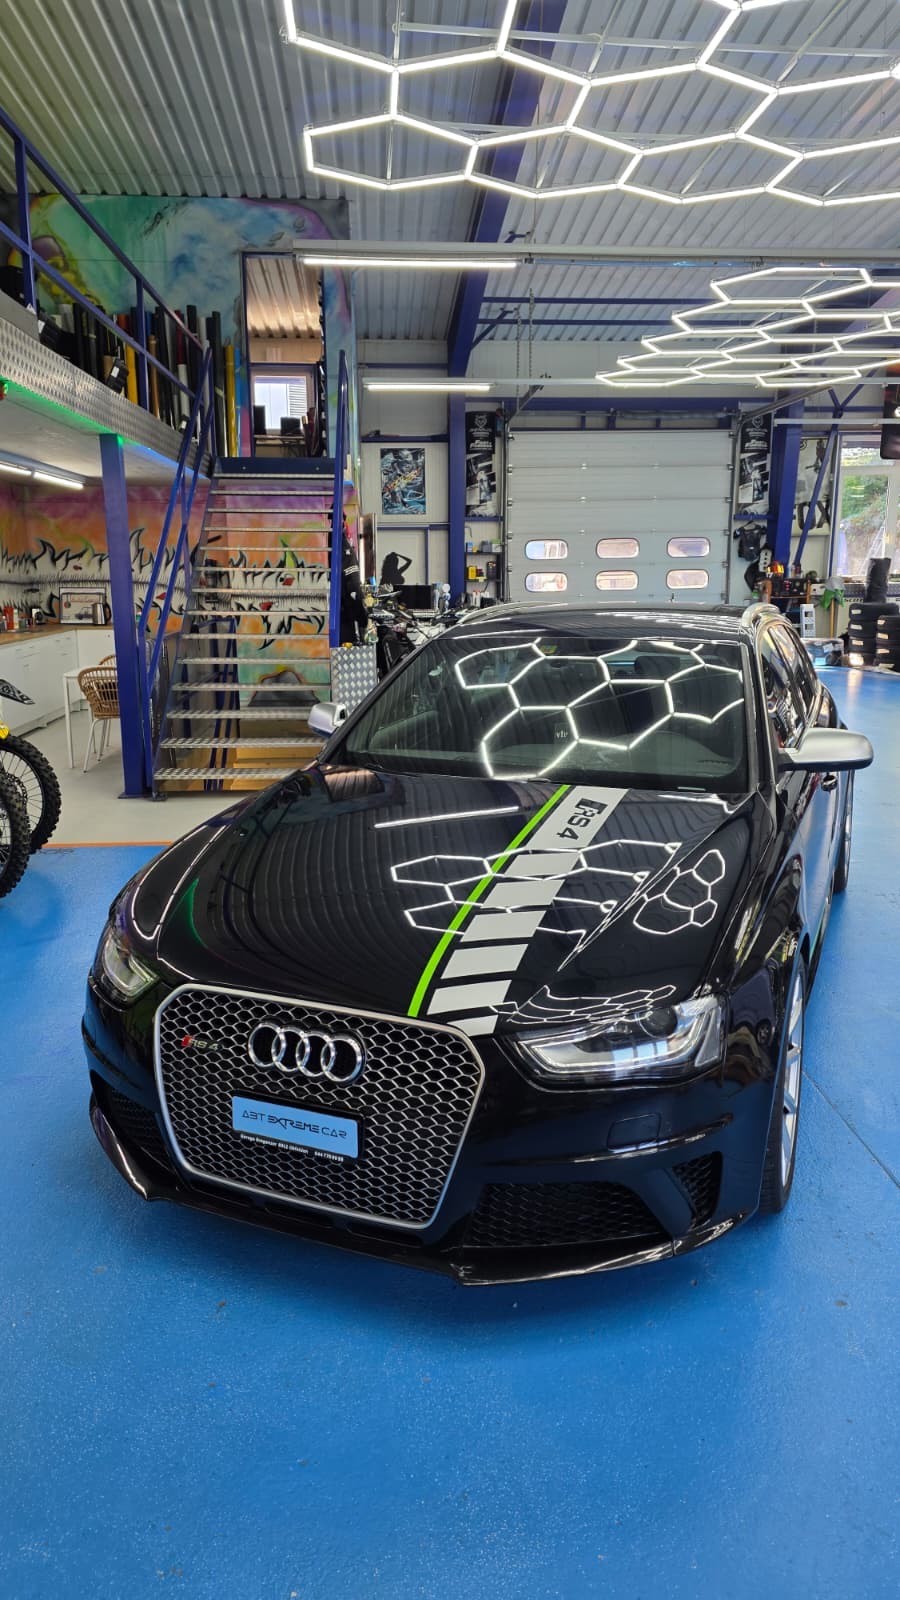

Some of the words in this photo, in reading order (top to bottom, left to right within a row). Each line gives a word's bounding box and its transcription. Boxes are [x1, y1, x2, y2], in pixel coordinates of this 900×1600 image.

[557, 799, 607, 840] RS4
[267, 1115, 320, 1134] EXTREME
[321, 1126, 348, 1139] CAR
